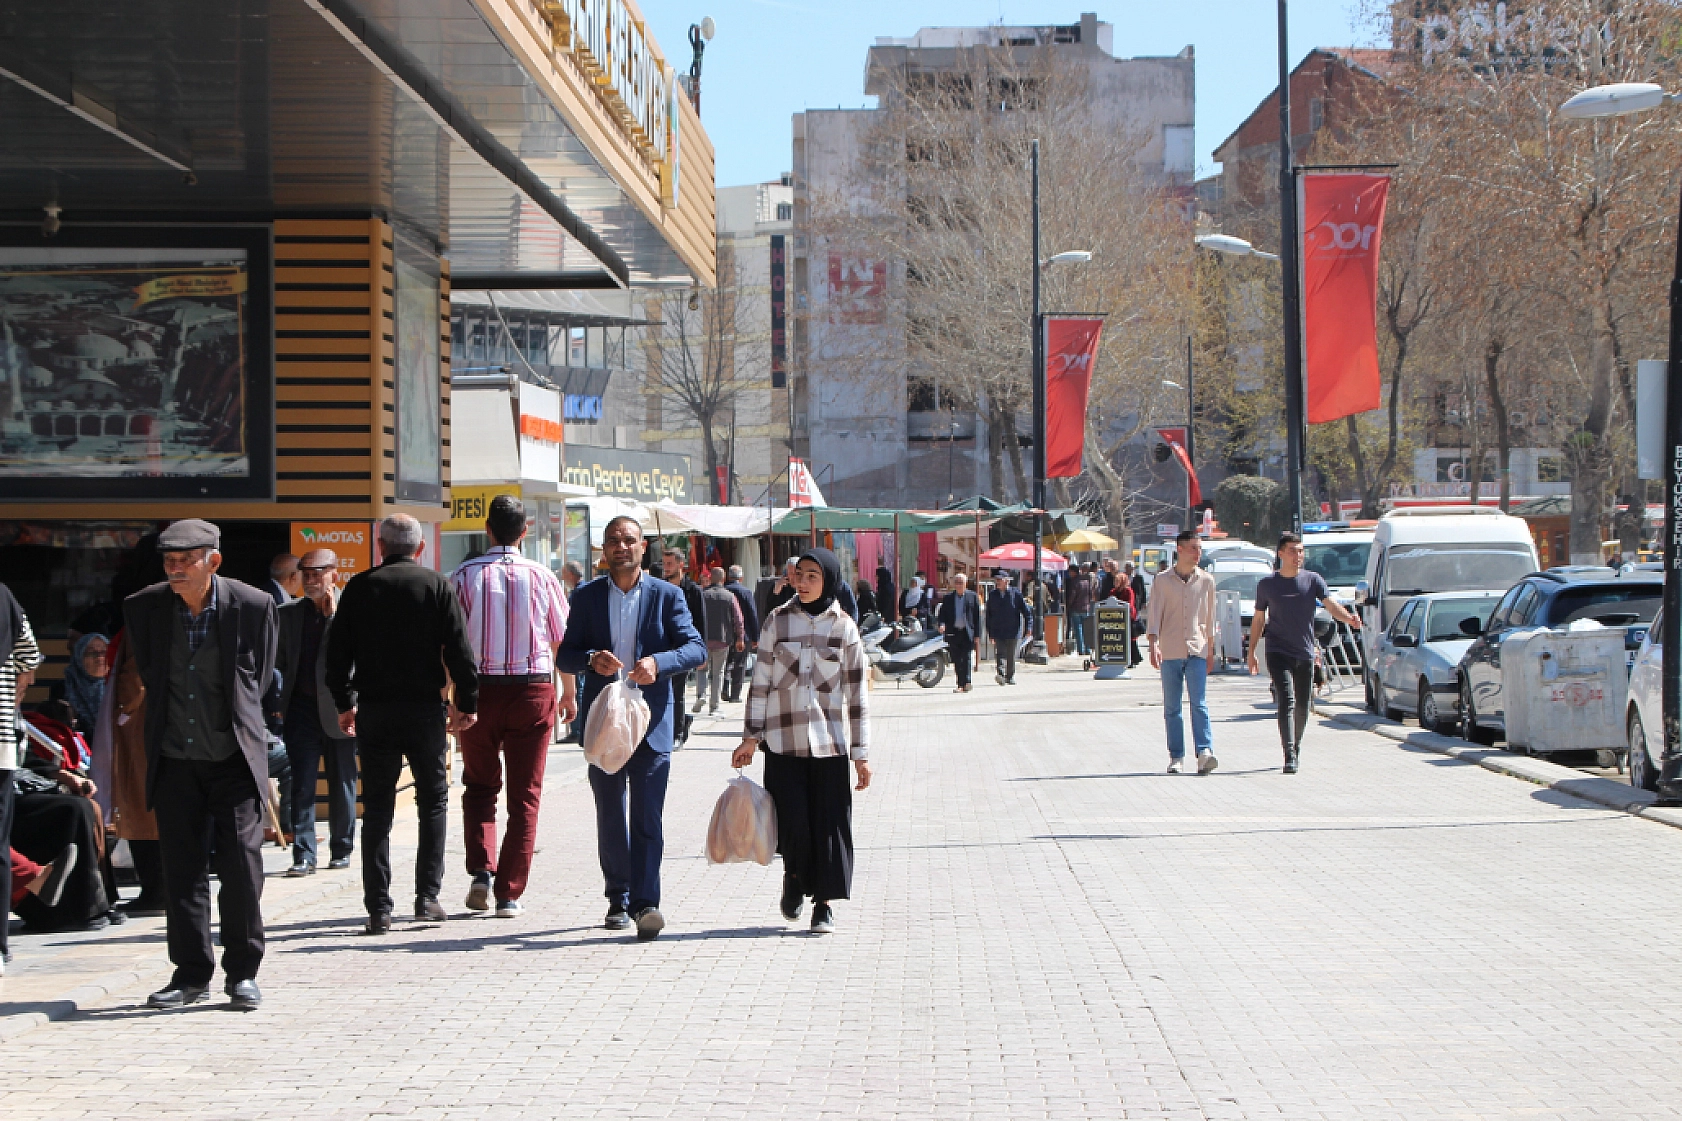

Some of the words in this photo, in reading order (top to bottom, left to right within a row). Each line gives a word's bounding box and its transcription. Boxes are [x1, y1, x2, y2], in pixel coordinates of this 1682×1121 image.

[592, 463, 633, 493] Perde
[633, 471, 651, 494] ve
[651, 467, 685, 502] Çeyiz
[317, 531, 364, 545] MOTAŞ
